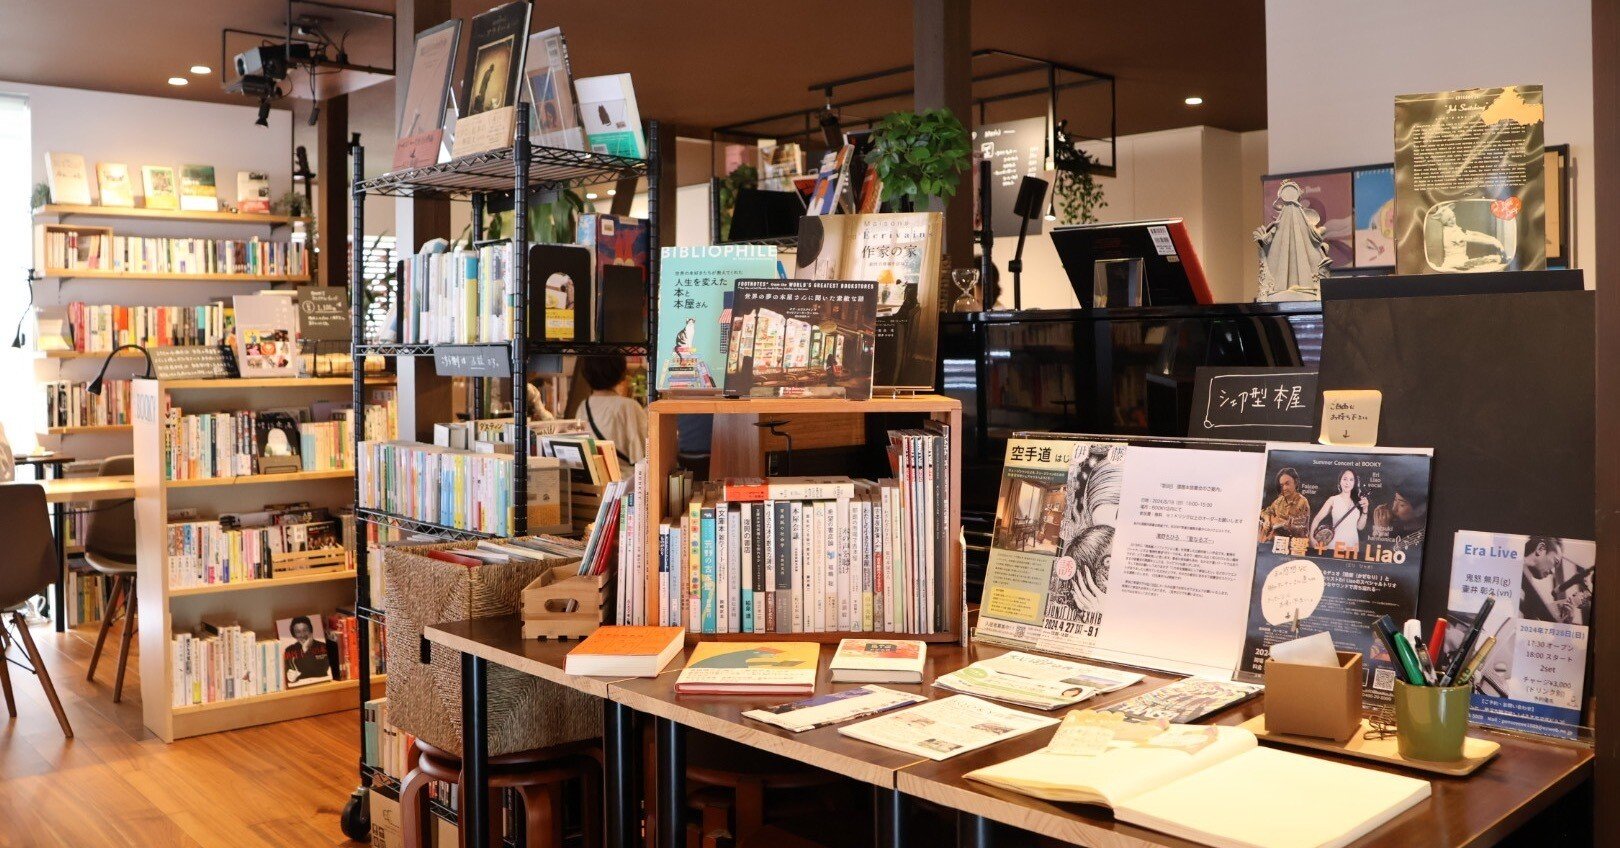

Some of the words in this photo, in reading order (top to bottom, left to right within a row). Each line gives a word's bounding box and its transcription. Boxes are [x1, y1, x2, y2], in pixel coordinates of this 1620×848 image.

[661, 245, 777, 258] BIBLIOPHILE
[862, 244, 917, 258] 作家の家
[675, 278, 728, 287] 人生を変えた
[673, 287, 690, 298] 本と
[744, 293, 865, 303] 世界の夢の本屋さんに聞いた素敵な話
[673, 298, 708, 310] 本屋さん
[1010, 445, 1051, 462] 空手道
[1333, 541, 1360, 560] Eri
[1364, 544, 1406, 564] Liao
[1464, 544, 1486, 556] Era
[1490, 546, 1518, 559] Live
[1546, 642, 1574, 652] オープン
[1546, 654, 1573, 662] スタート
[1540, 665, 1556, 673] 2set
